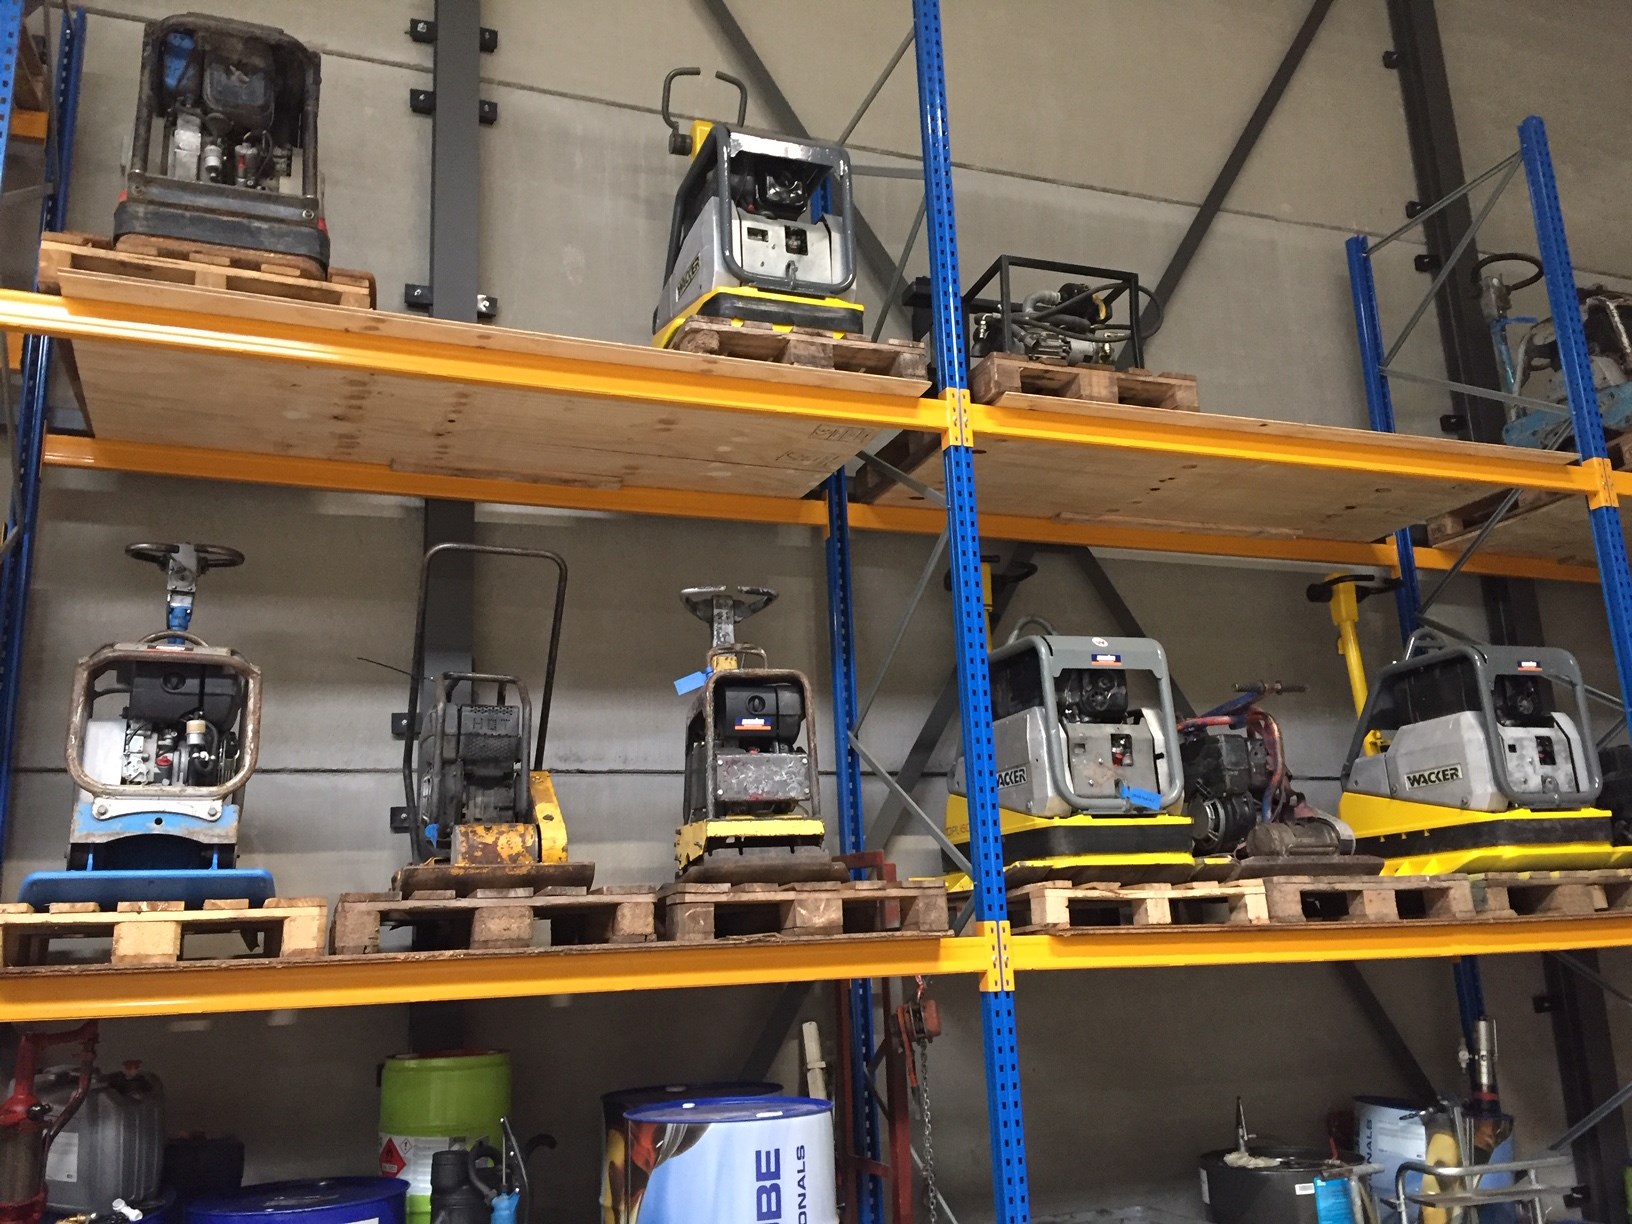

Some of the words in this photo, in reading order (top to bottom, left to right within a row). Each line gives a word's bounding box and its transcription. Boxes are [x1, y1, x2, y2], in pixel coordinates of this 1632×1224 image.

[997, 768, 1026, 788] ACKER
[1406, 767, 1459, 787] WACKER
[755, 1148, 782, 1224] BE
